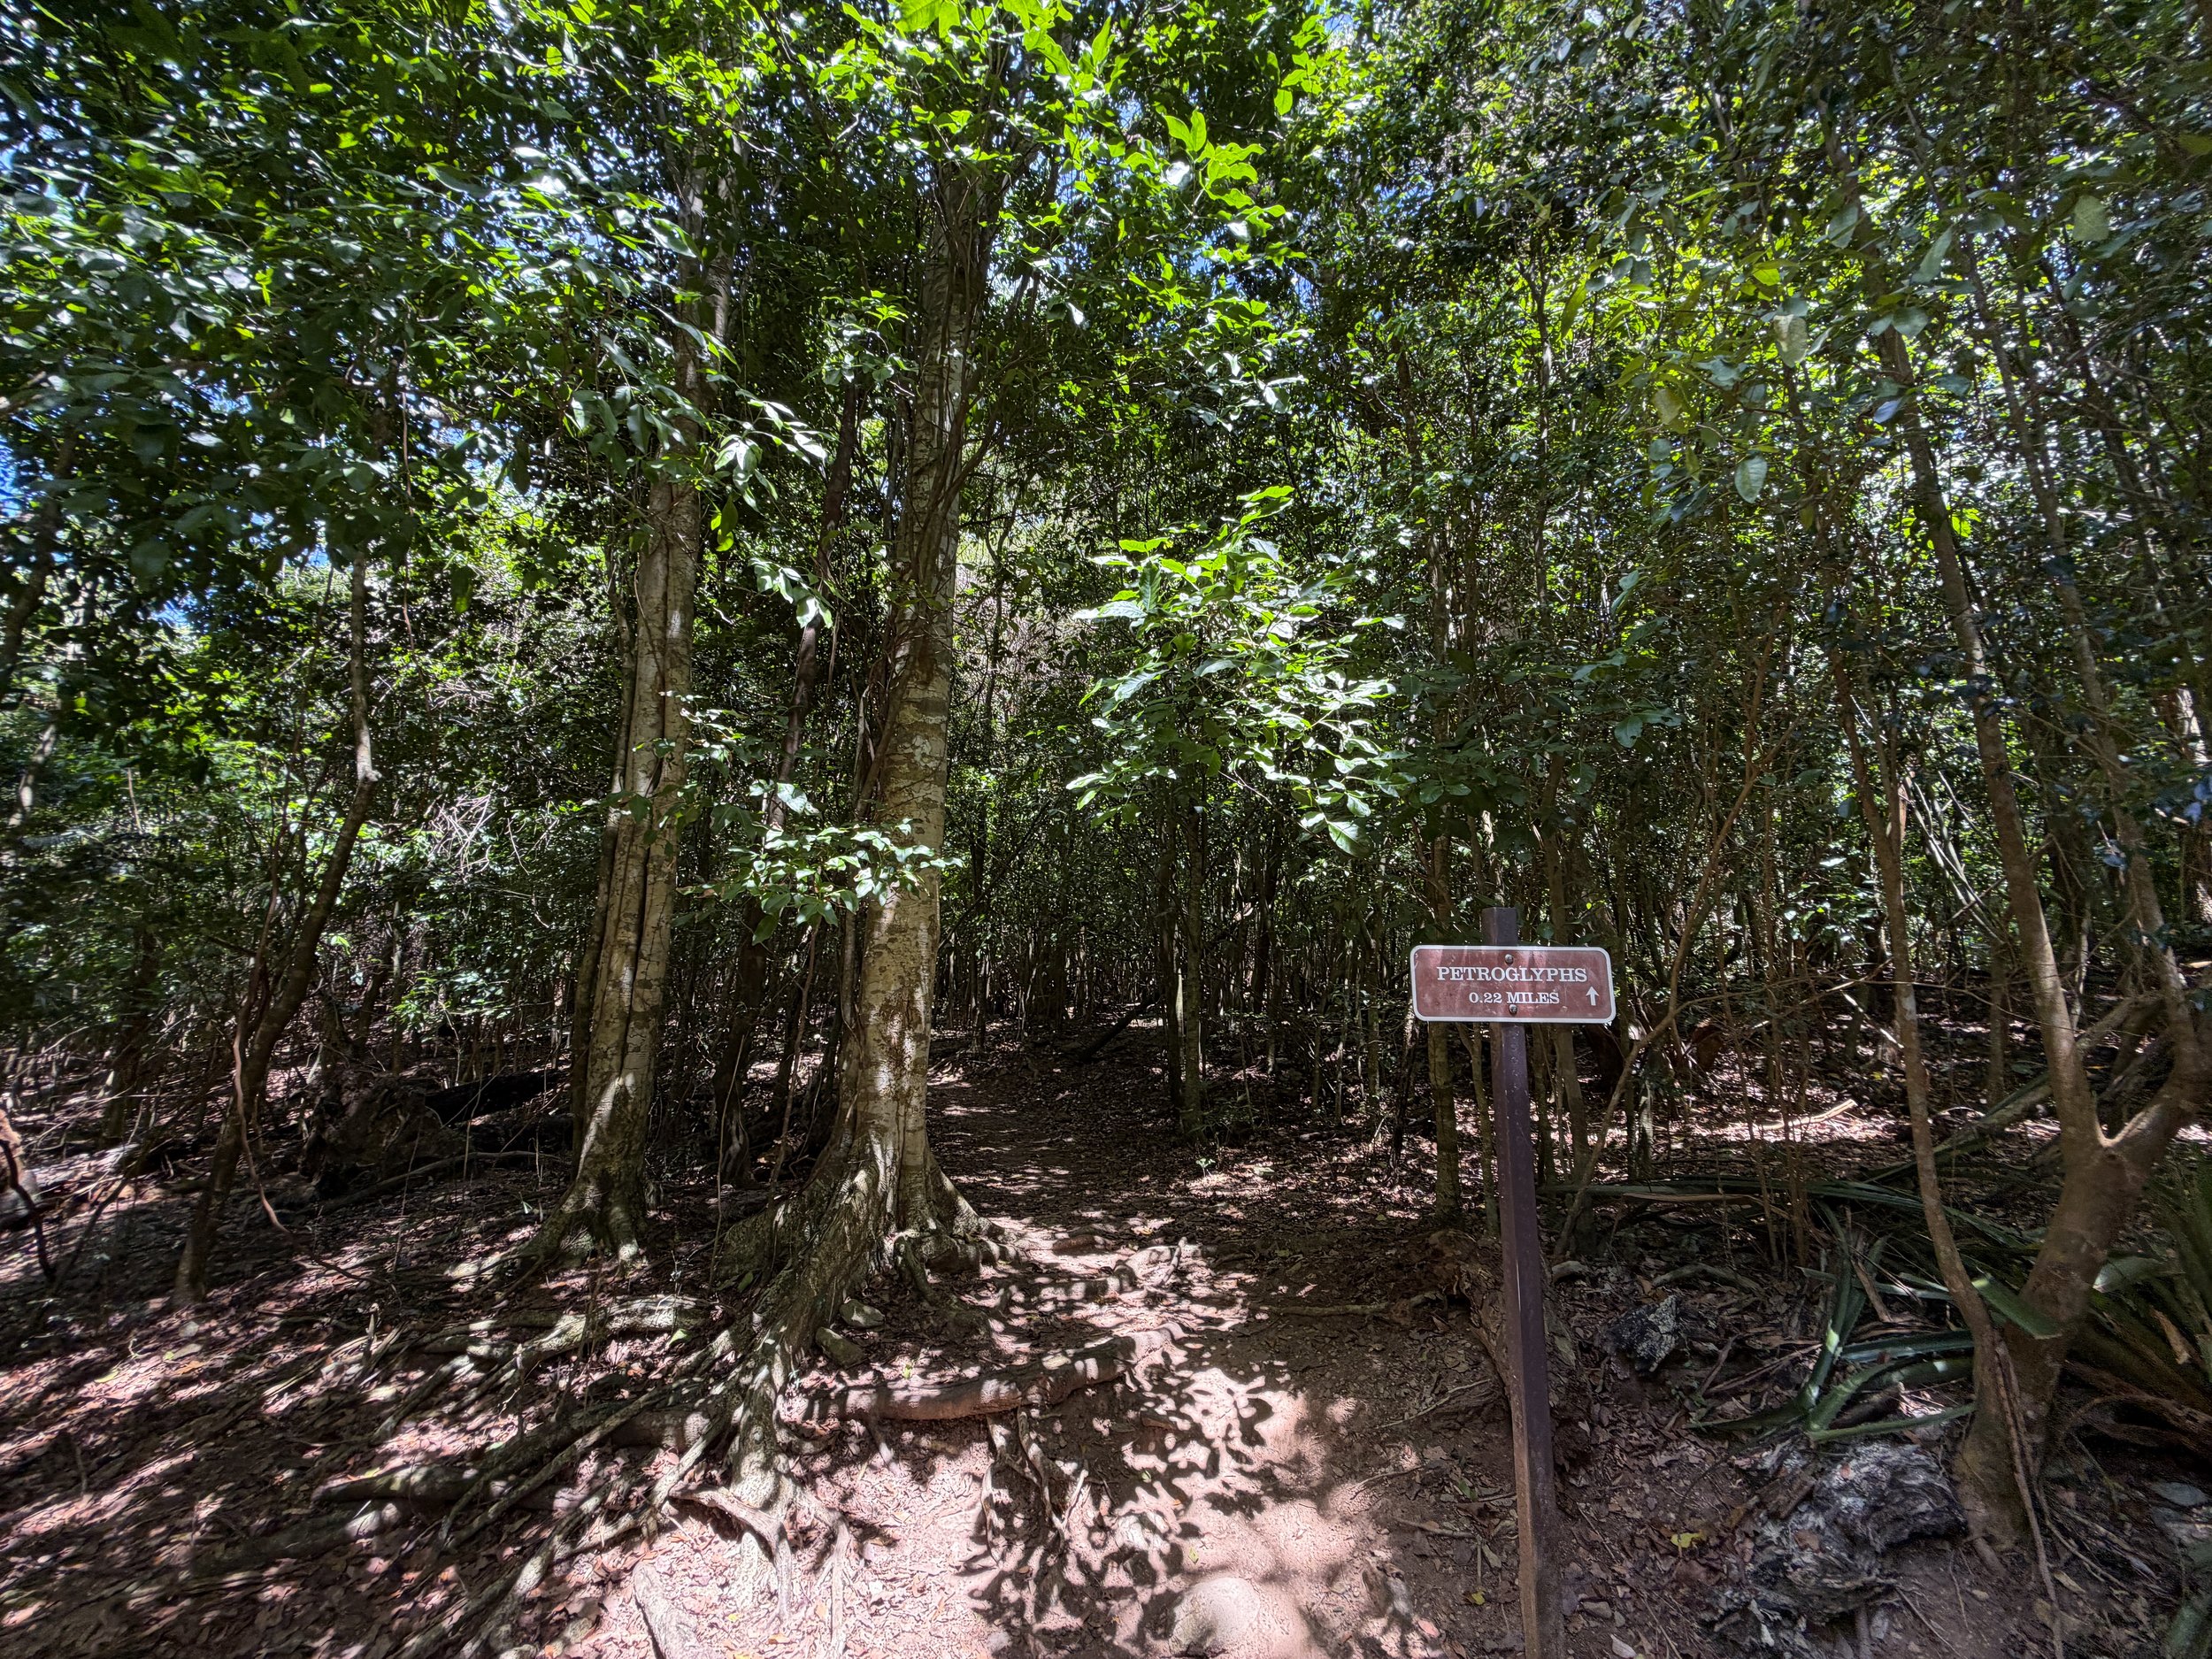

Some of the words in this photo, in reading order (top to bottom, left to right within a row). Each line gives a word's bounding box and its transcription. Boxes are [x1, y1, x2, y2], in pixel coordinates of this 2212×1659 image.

[1436, 966, 1587, 982] PETROGLYPHS
[1469, 992, 1502, 1004] 0.22
[1506, 992, 1560, 1004] MILES
